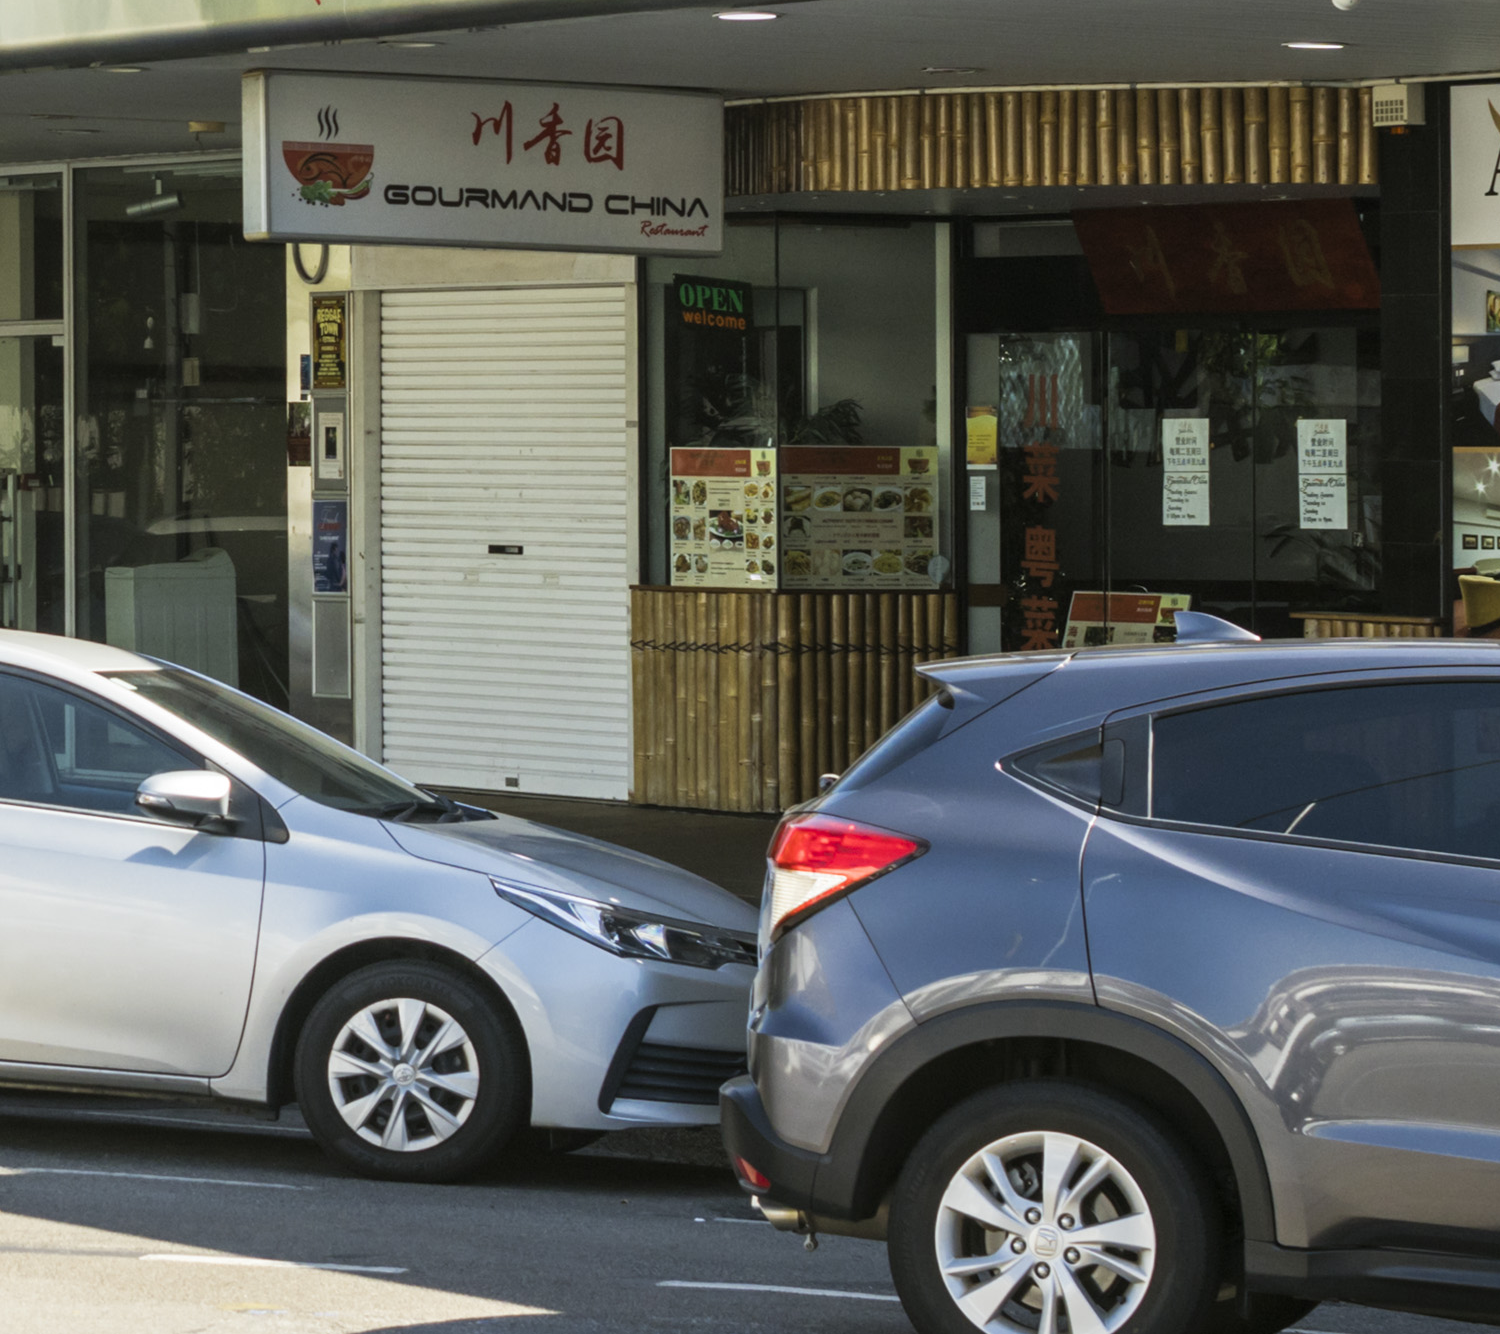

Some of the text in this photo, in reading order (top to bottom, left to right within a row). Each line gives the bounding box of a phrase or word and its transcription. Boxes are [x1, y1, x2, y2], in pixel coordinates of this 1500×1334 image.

[471, 99, 625, 172] 川香园
[383, 183, 710, 219] GOURMAND CHINA
[640, 219, 710, 238] Restaurant
[679, 282, 744, 313] OPEN
[682, 309, 747, 330] welcome
